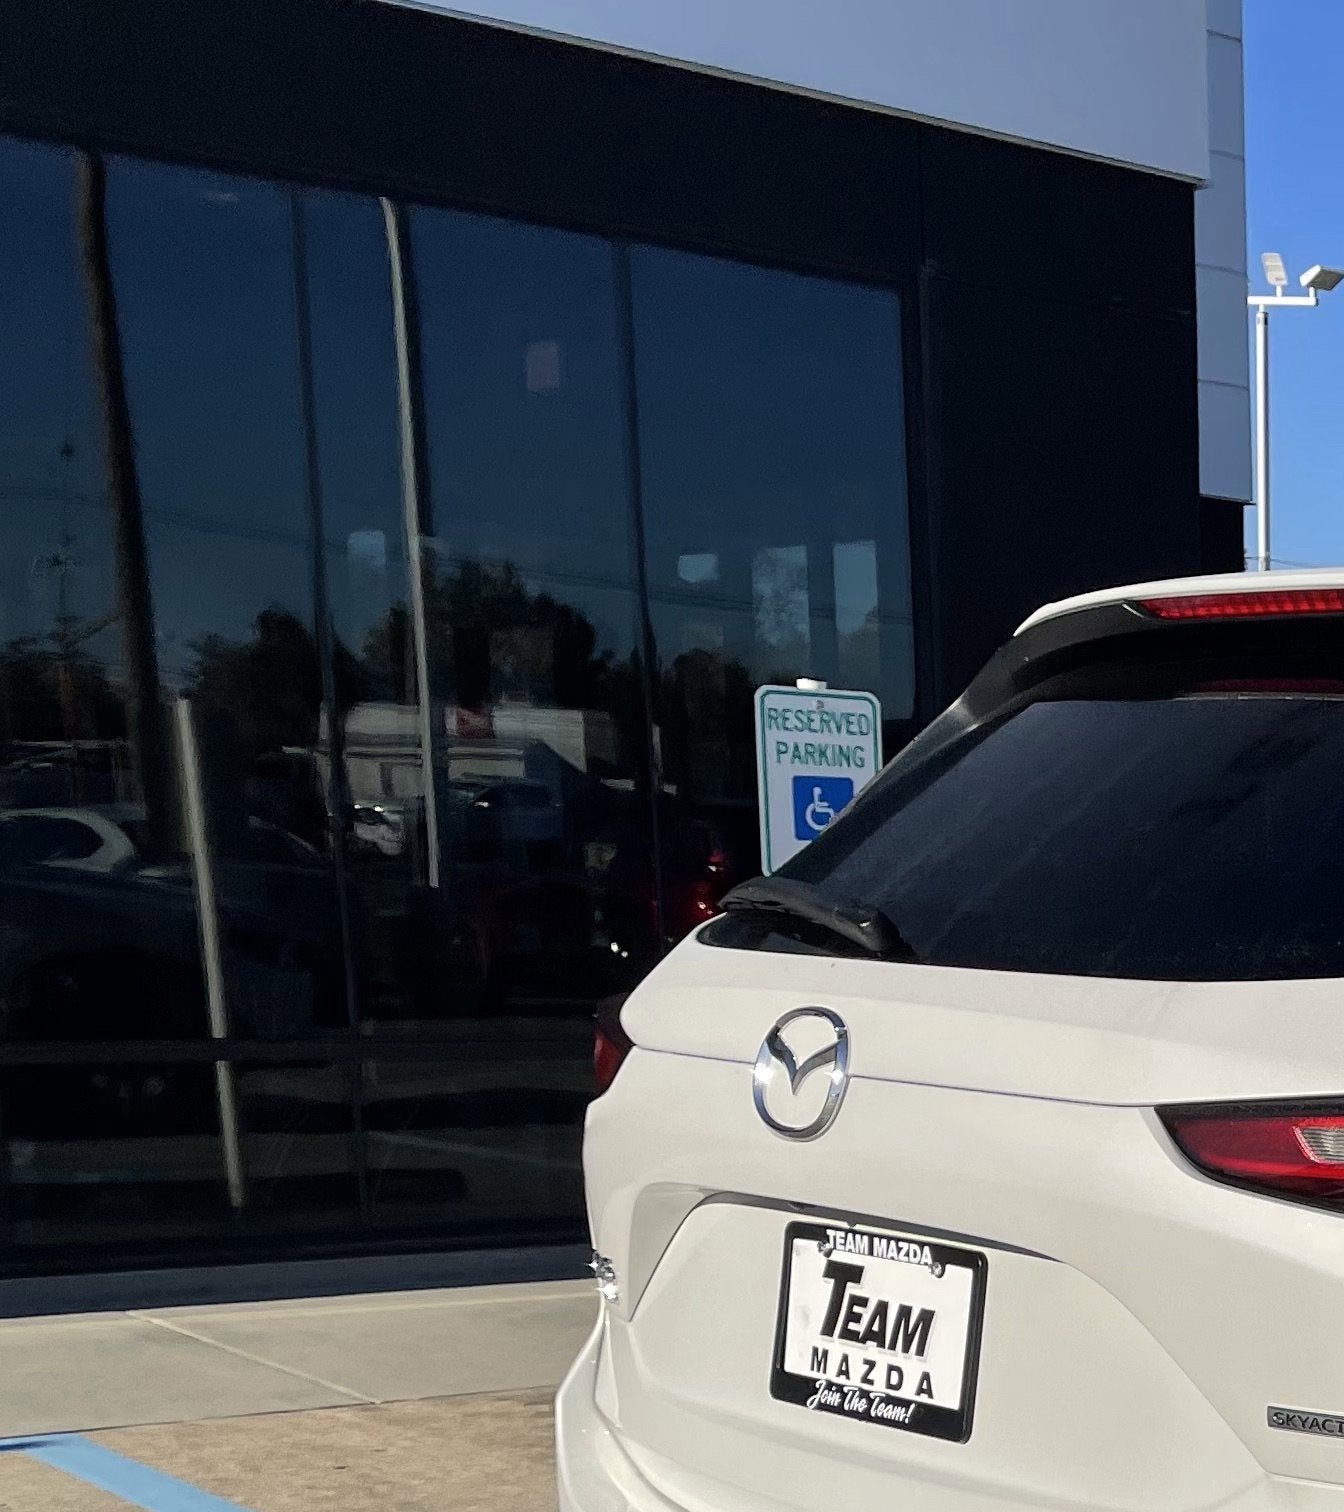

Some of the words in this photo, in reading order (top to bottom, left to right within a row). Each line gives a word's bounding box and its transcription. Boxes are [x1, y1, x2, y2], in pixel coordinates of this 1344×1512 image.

[767, 708, 871, 736] RESERVED
[776, 741, 865, 768] PARKING
[825, 1229, 869, 1255] TEAM
[873, 1237, 933, 1265] MAZDA
[810, 1346, 934, 1399] MAZDA
[807, 1379, 842, 1410] Join
[843, 1386, 867, 1413] The
[869, 1392, 916, 1424] Team!
